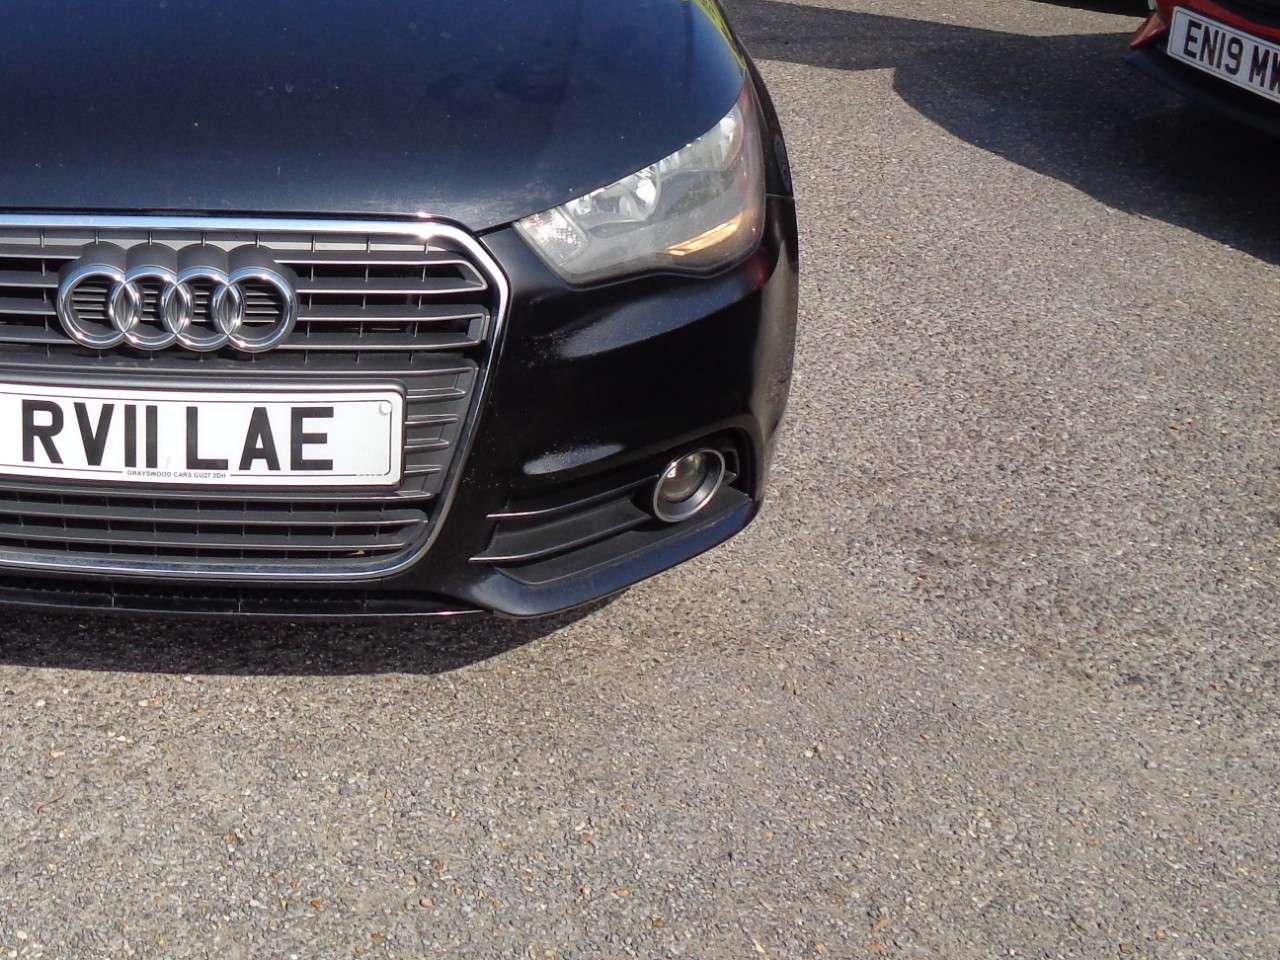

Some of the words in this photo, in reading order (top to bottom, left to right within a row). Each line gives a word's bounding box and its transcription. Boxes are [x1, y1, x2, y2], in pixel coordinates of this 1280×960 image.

[1183, 19, 1244, 76] EN19
[21, 399, 158, 469] RV11
[186, 406, 335, 471] LAE
[127, 470, 172, 478] GRAYSWOOD
[173, 471, 193, 479] CARS
